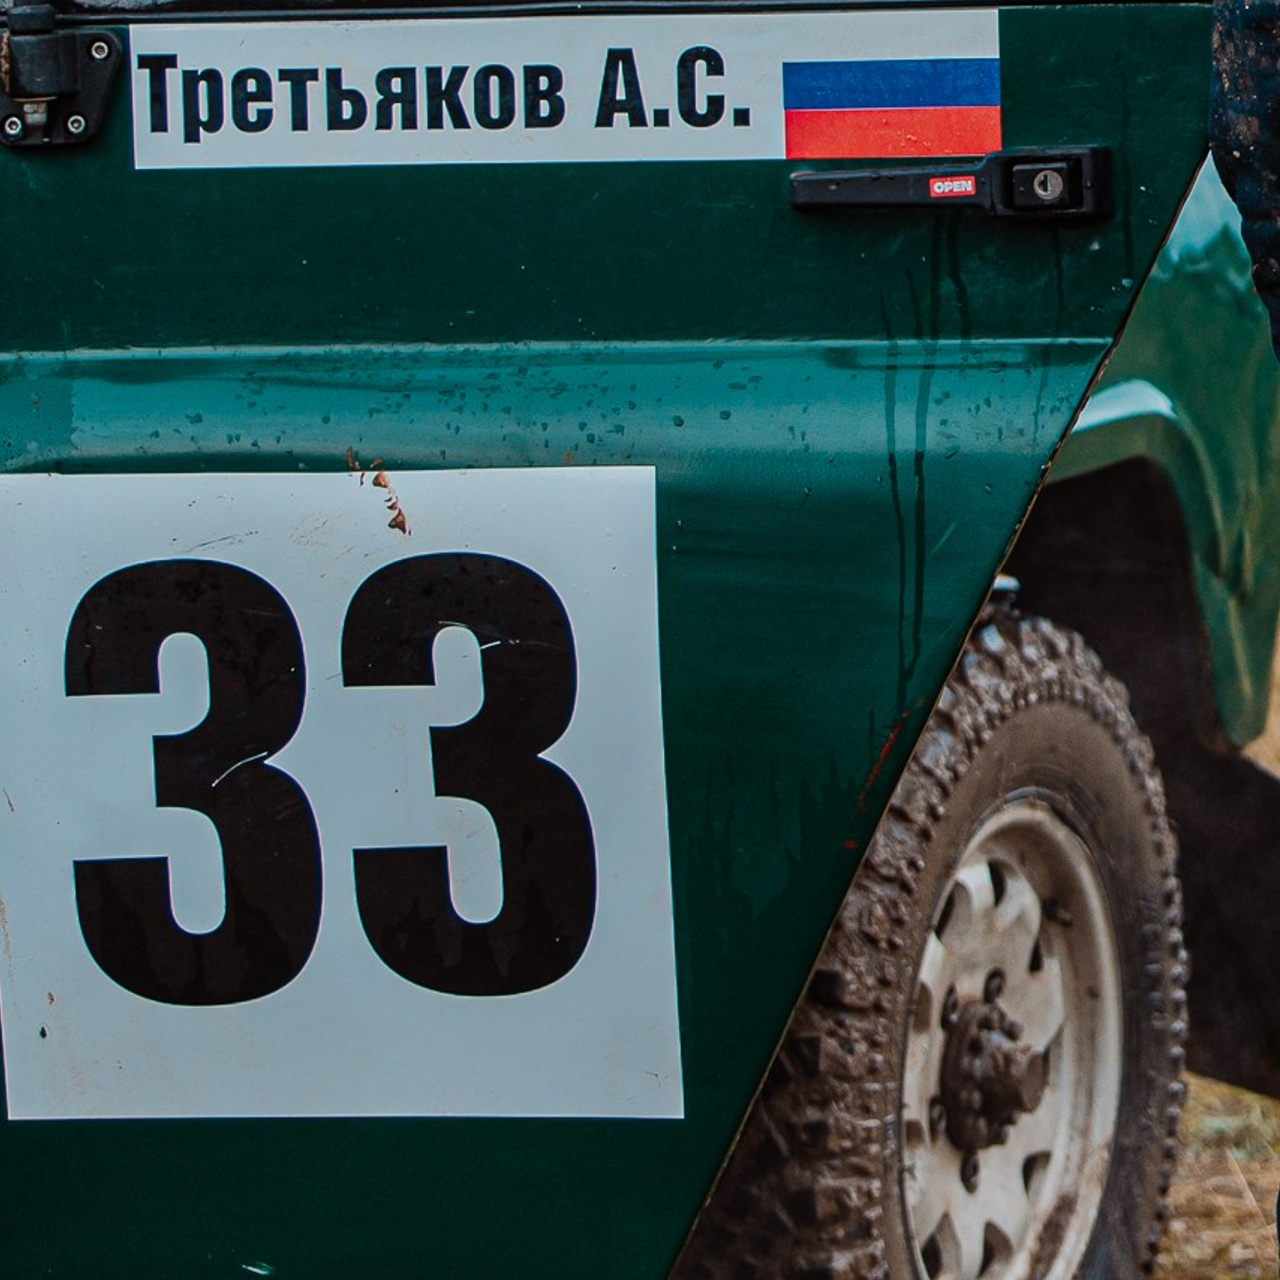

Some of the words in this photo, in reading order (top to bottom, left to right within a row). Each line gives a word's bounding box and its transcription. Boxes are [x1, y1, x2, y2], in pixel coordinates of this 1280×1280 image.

[136, 53, 566, 144] Третьяков
[593, 45, 751, 129] А.С.
[933, 179, 973, 193] OPEN
[63, 551, 597, 1006] 33
